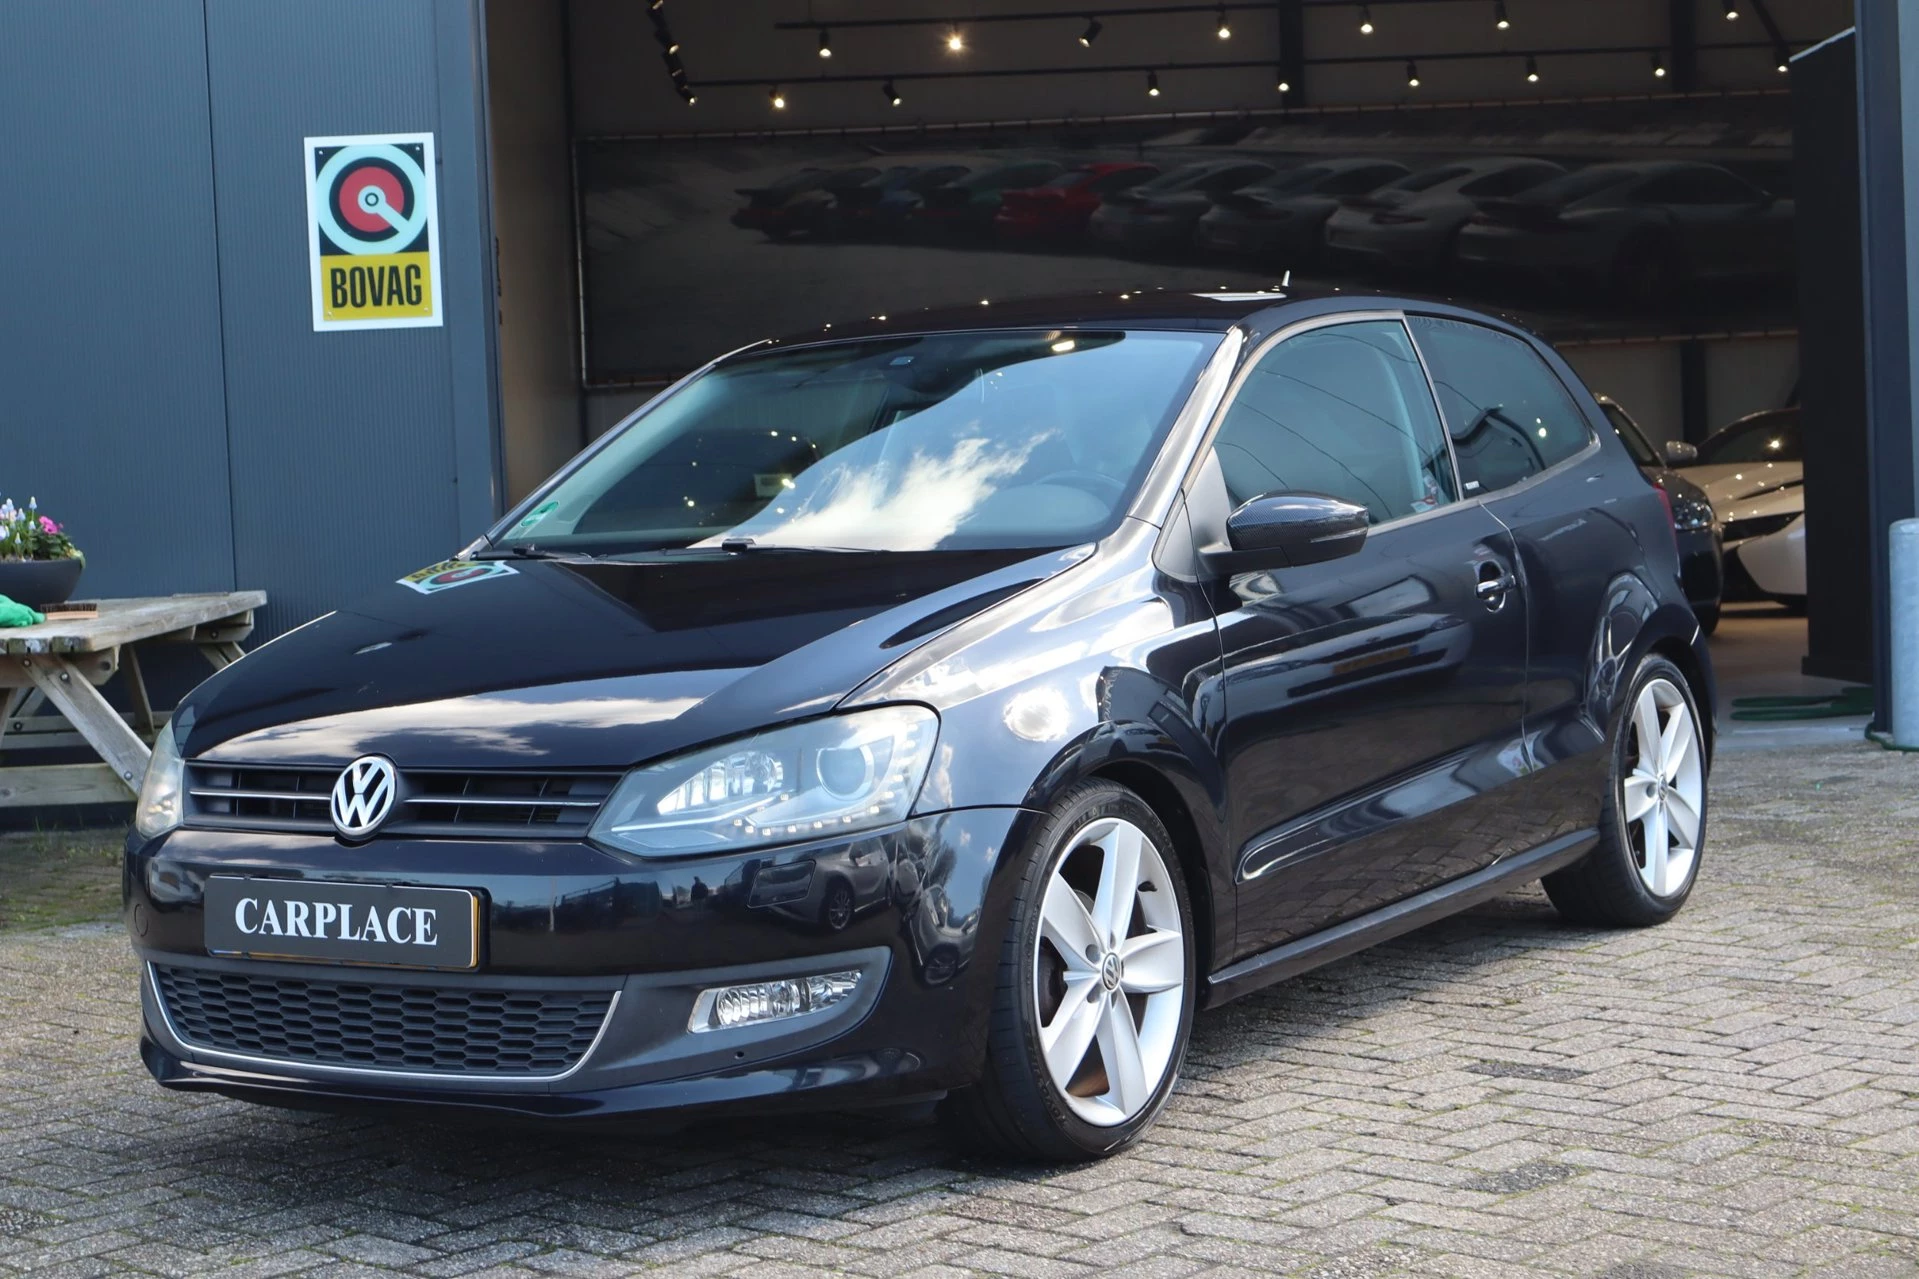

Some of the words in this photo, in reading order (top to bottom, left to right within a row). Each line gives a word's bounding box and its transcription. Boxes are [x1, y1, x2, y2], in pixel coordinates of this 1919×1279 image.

[330, 264, 422, 308] BOVAG
[334, 759, 393, 831] VW
[234, 897, 439, 946] CARPLACE
